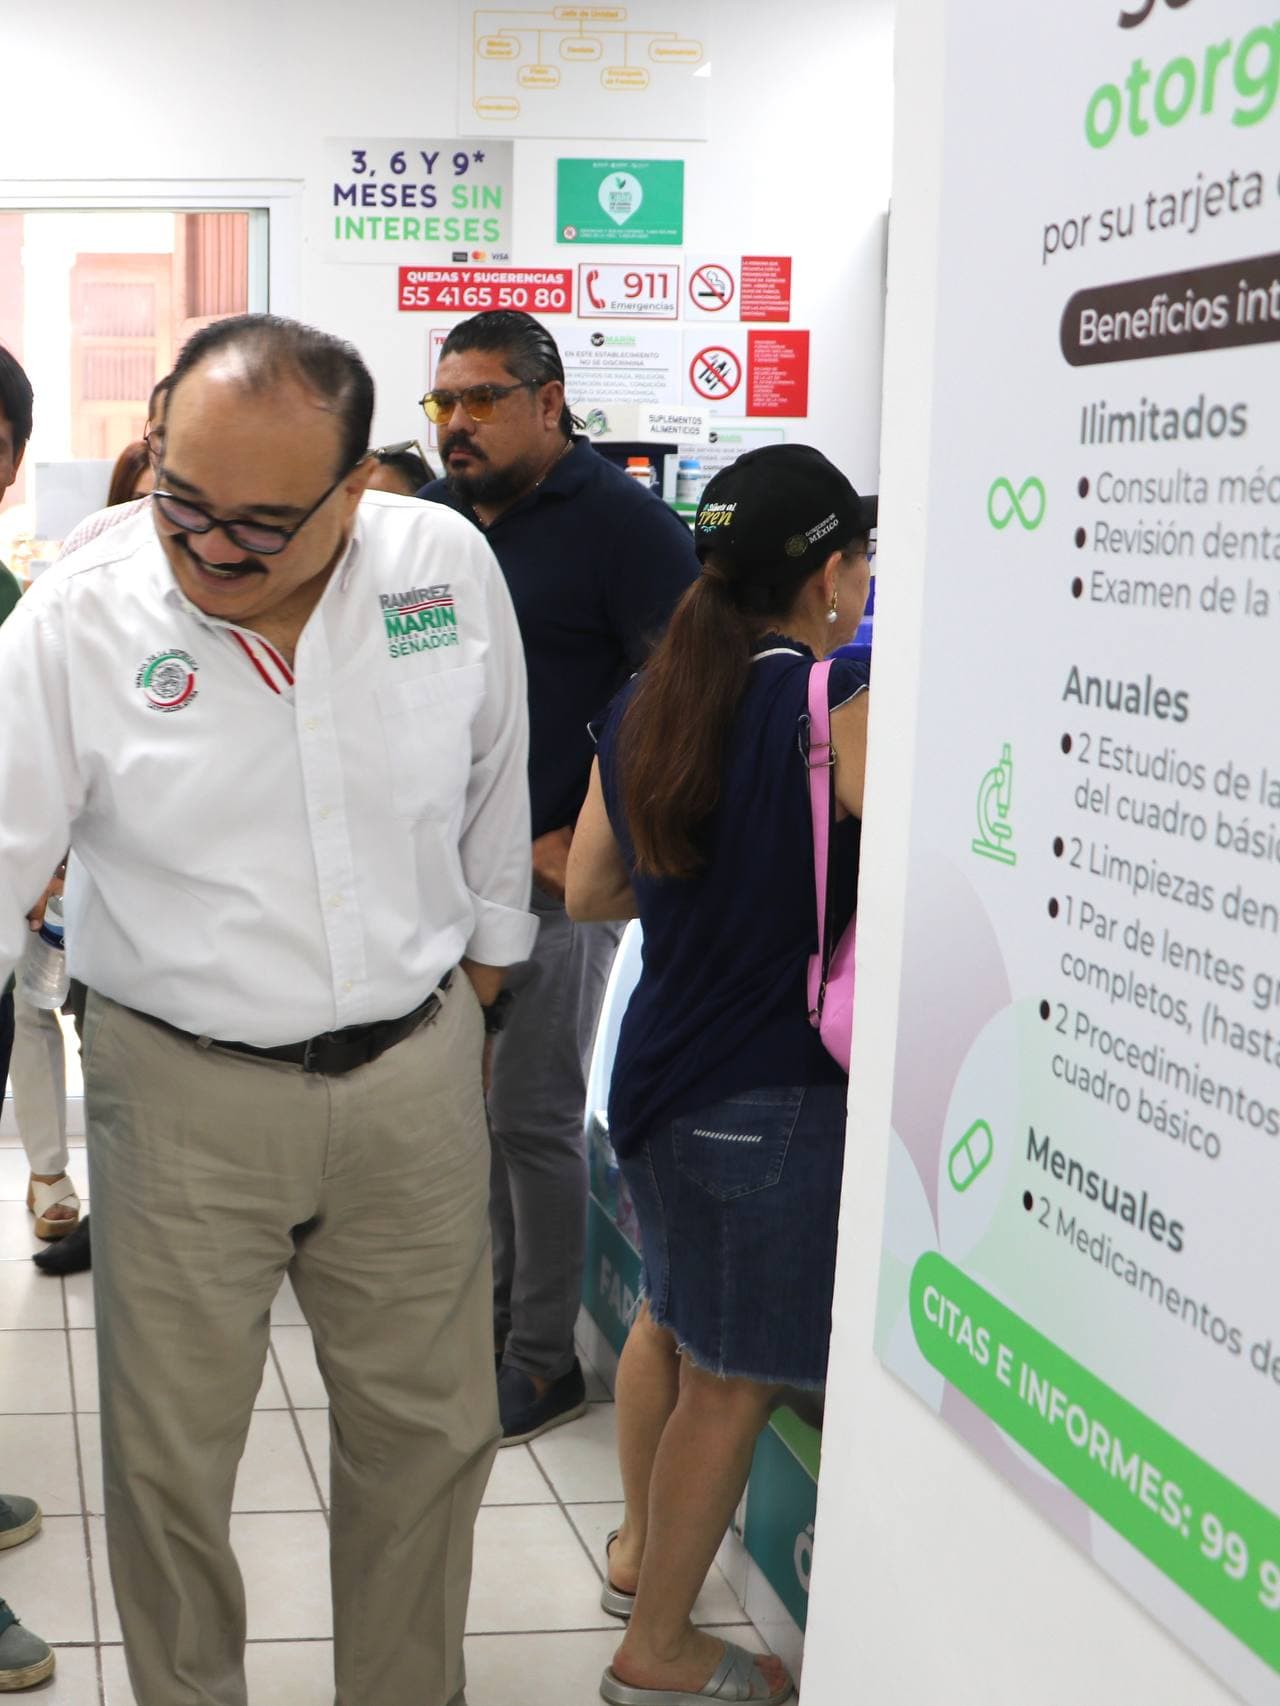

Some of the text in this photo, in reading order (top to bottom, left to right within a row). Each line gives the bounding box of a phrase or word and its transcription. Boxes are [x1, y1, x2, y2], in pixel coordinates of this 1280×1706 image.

[352, 150, 376, 177] 3,
[390, 151, 407, 175] 6
[421, 151, 440, 175] Y
[333, 183, 502, 209] MESES SIN
[1042, 170, 1263, 266] por su tarjeta
[334, 216, 500, 242] INTERESES
[401, 286, 430, 306] 55
[498, 287, 528, 307] 50
[534, 288, 566, 308] 80
[407, 271, 564, 285] QUEJAS Y SUGERENCIAS
[623, 272, 669, 299] 911
[610, 301, 675, 313] Emergencias
[1079, 289, 1228, 346] Beneficios
[649, 414, 702, 425] SUPLEMENTOS
[650, 426, 701, 435] ALIMENTICIOS
[1080, 393, 1248, 445] Ilimitados
[1096, 468, 1209, 504] Consulta
[1093, 518, 1195, 558] Revisión
[379, 584, 451, 610] RAMÍREZ
[1090, 570, 1269, 618] Examen de la
[389, 632, 460, 659] SENADOR
[1062, 664, 1190, 723] Anuales
[1078, 732, 1091, 763] 2
[1098, 735, 1206, 791] Estudios
[1213, 759, 1250, 801] de
[1074, 778, 1109, 816] del
[1116, 793, 1207, 843] cuadro
[1069, 837, 1280, 936] 2 Limpiezas den
[1065, 895, 1074, 926] 1
[1079, 900, 1117, 943] Par
[1123, 917, 1155, 958] de
[1162, 928, 1245, 992] lentes
[1060, 951, 1193, 1036] completos,
[1055, 1003, 1280, 1137] 2 Procedimientos
[1052, 1054, 1221, 1161] cuadro básico
[1026, 1126, 1185, 1254] Mensuales
[1038, 1196, 1051, 1229] 2
[1056, 1207, 1243, 1356] Medicamentos
[922, 1284, 991, 1367] CITAS
[995, 1345, 1014, 1388] E
[1018, 1362, 1193, 1539] INFORMES:
[1199, 1512, 1250, 1581] 99
